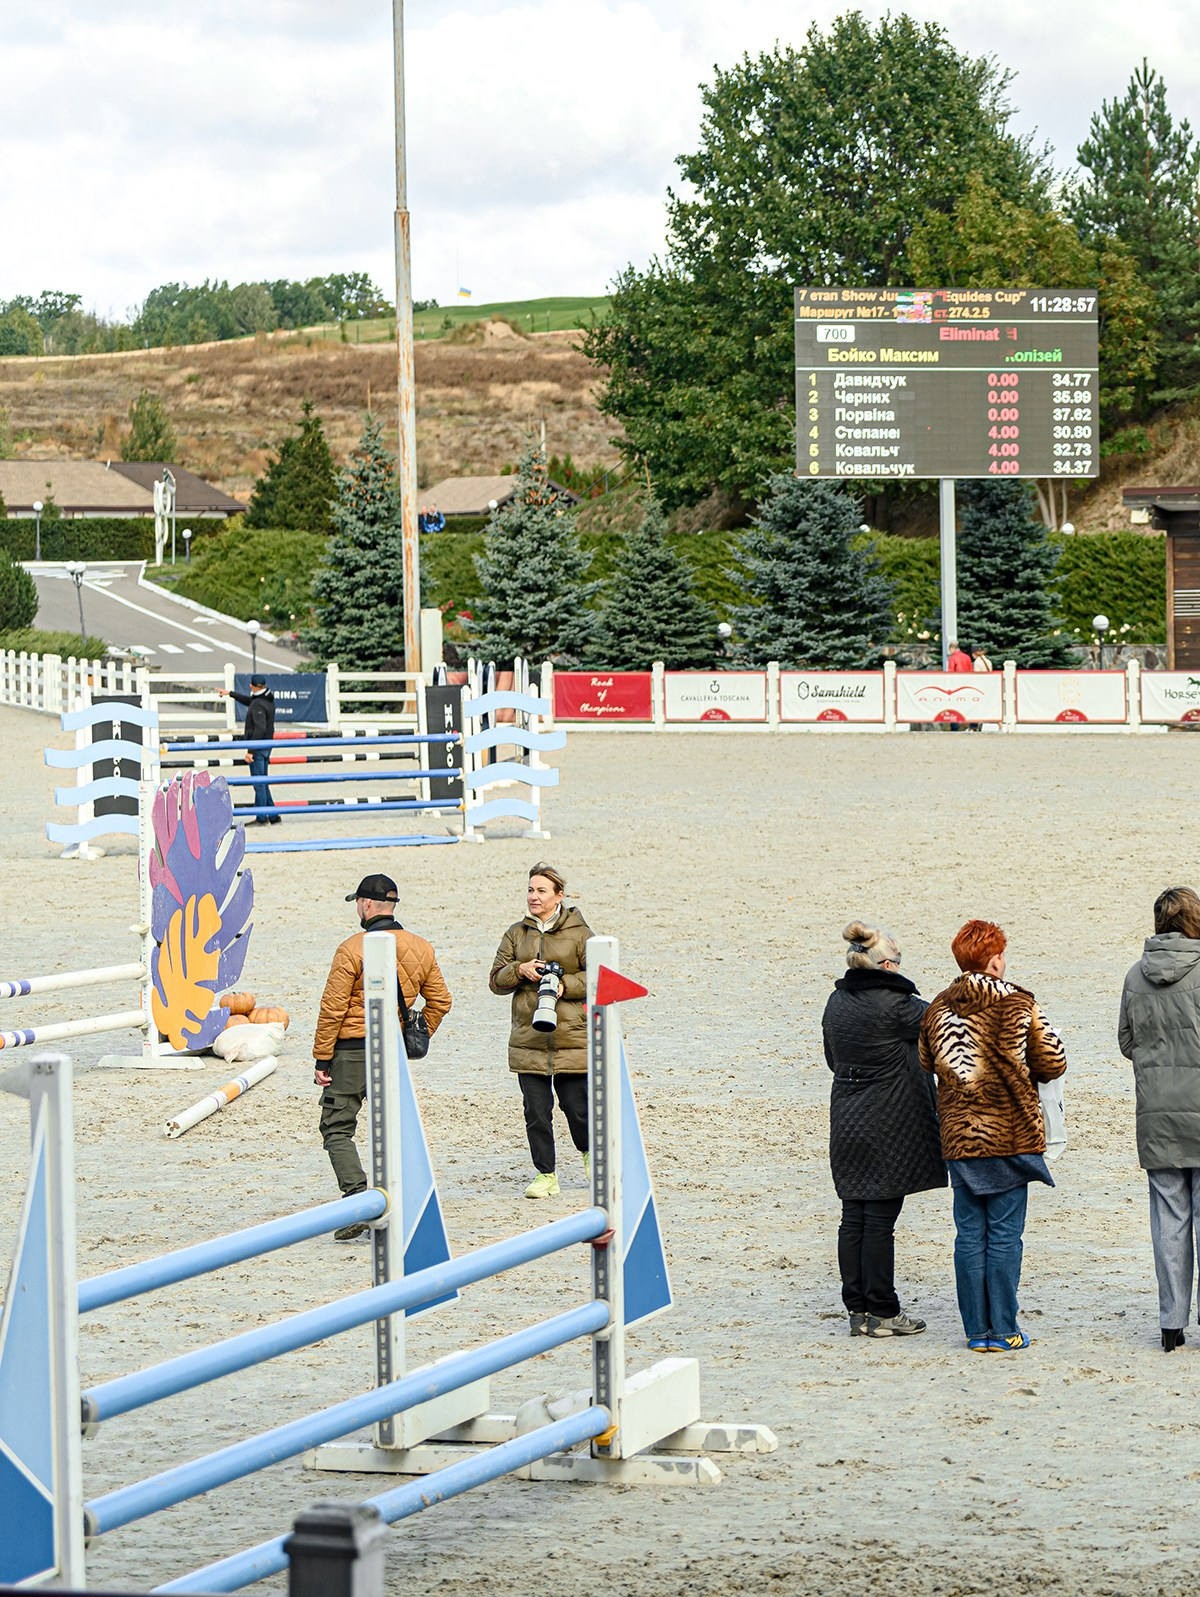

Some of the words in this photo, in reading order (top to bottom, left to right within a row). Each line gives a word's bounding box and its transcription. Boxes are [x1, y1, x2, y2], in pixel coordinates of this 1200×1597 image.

[799, 289, 807, 302] 7
[809, 290, 839, 302] етап
[841, 290, 877, 302] Show
[1029, 297, 1097, 313] 11:28:57
[799, 306, 855, 319] Маршрут
[823, 328, 848, 340] 700
[939, 327, 1018, 341] Eliminatd
[827, 348, 877, 362] Бойко
[879, 348, 940, 362] Максим
[808, 373, 819, 387] 1
[833, 373, 908, 390] Давидчук
[987, 373, 1019, 387] 0.00
[1052, 373, 1092, 387] 34.77
[808, 390, 819, 404] 2
[834, 390, 891, 407] Черних
[987, 390, 1019, 404] 0.00
[1052, 390, 1092, 404] 35.99
[808, 408, 819, 422] 3
[834, 407, 896, 424] Порвіна
[987, 408, 1019, 422] 0.00
[1052, 408, 1092, 422] 37.62
[808, 425, 819, 439] 4
[987, 425, 1019, 439] 4.00
[1052, 425, 1092, 439] 30.80
[808, 443, 819, 457] 5
[987, 443, 1019, 457] 4.00
[1052, 443, 1092, 457] 32.73
[808, 460, 819, 474] 6
[836, 461, 916, 477] Ковальчук
[987, 460, 1019, 474] 4.00
[1052, 460, 1092, 474] 34.37
[274, 690, 297, 700] RINA
[597, 689, 608, 702] of
[580, 703, 626, 716] Champions
